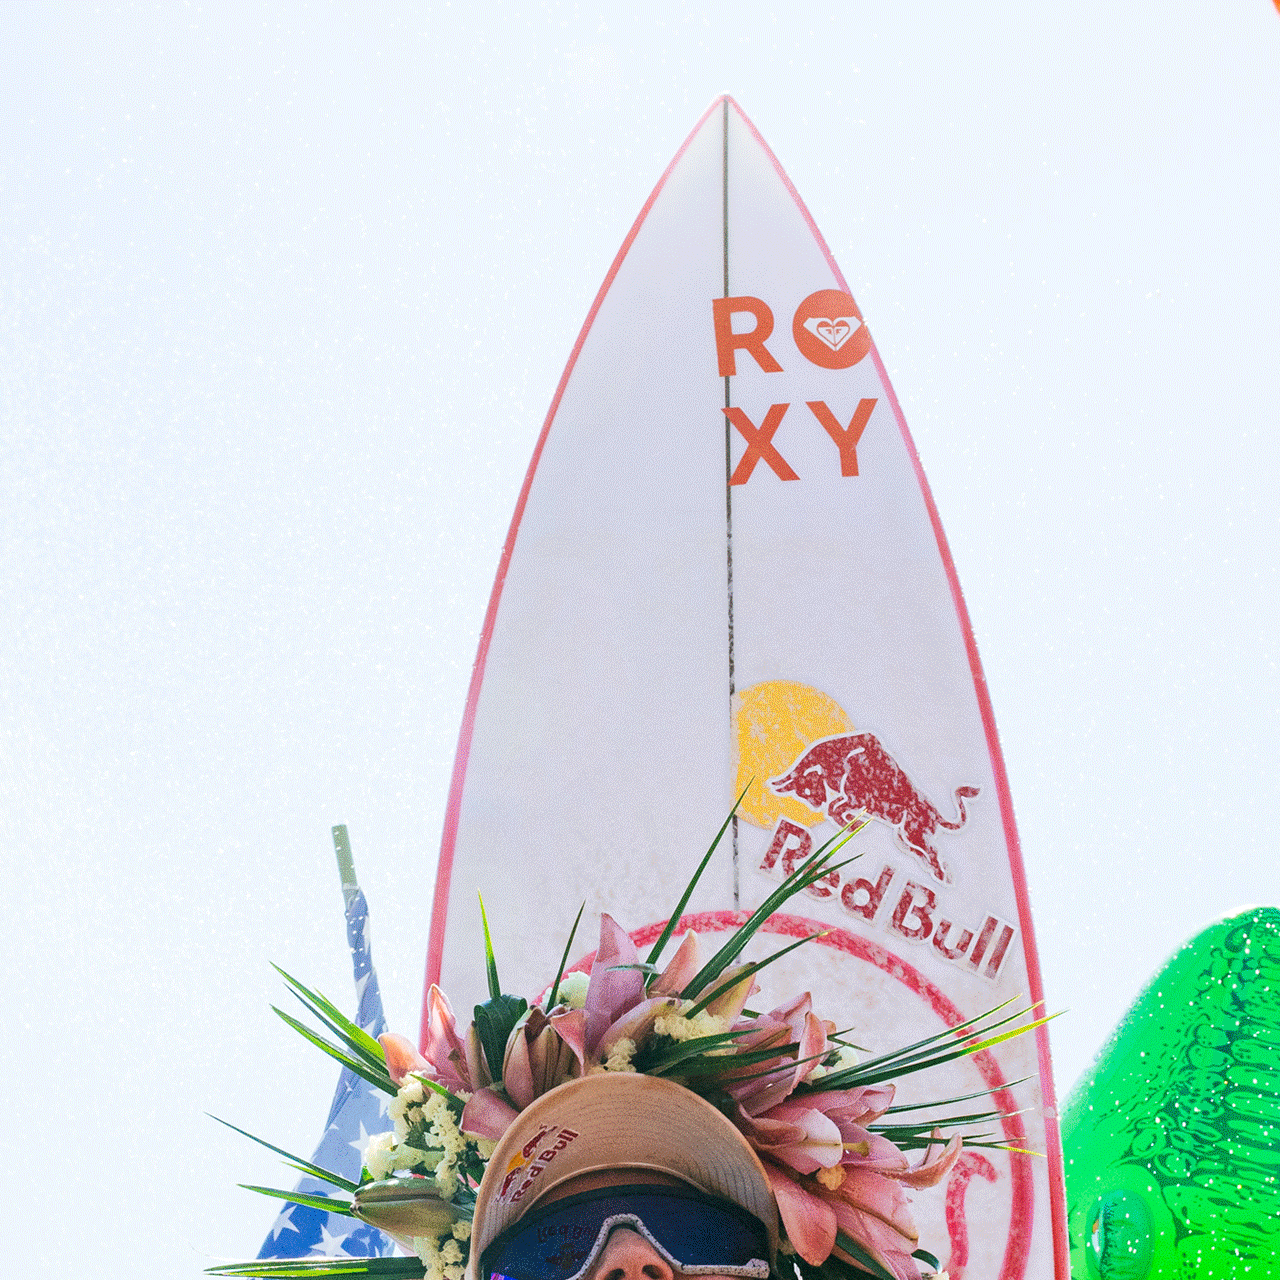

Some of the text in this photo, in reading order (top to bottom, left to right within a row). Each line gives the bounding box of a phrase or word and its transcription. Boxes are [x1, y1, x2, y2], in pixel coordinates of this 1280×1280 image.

[721, 397, 879, 487] XY
[758, 816, 1015, 979] Red Bull
[538, 1128, 579, 1162] Bull
